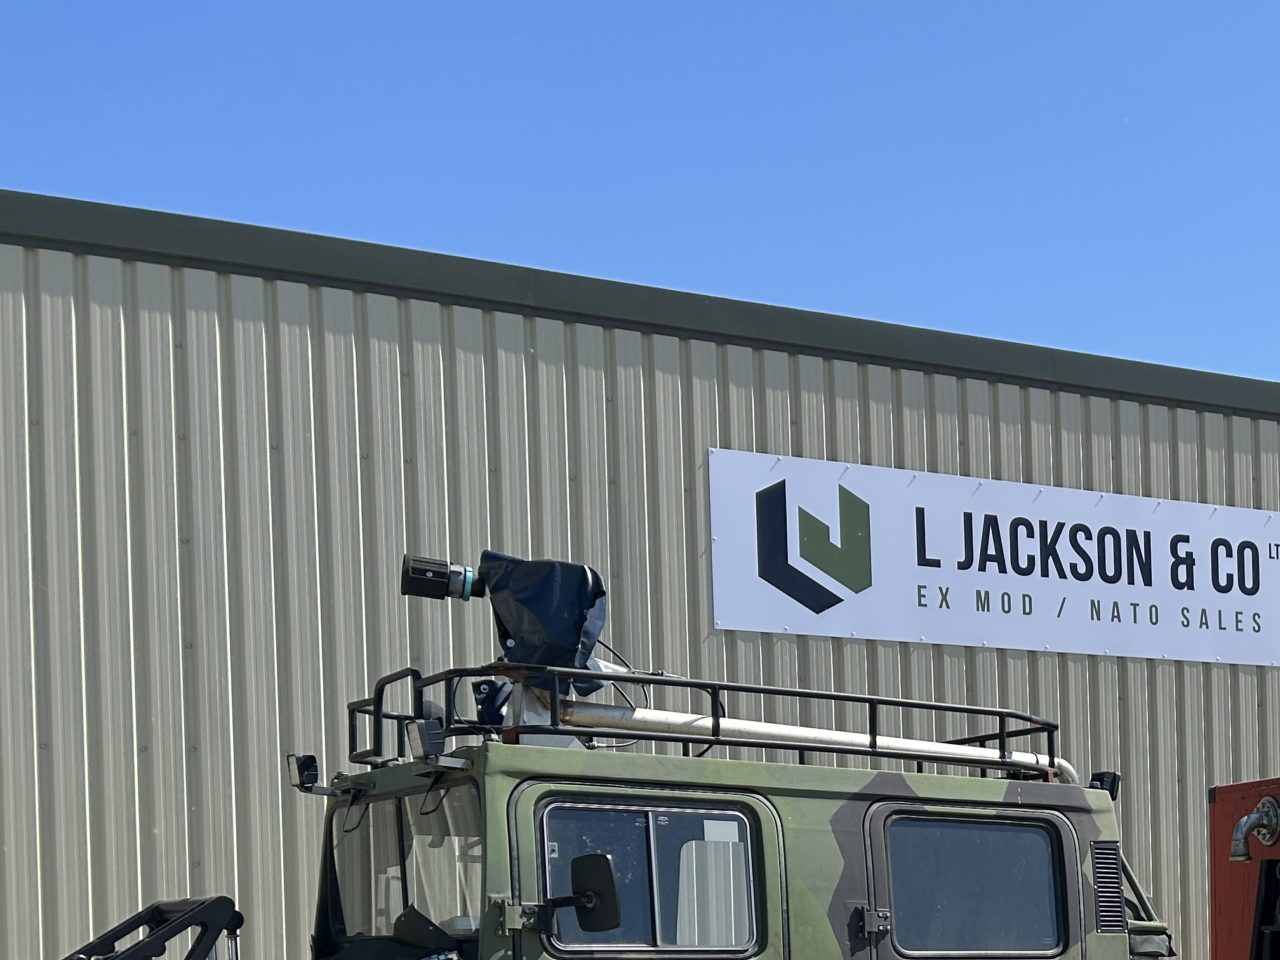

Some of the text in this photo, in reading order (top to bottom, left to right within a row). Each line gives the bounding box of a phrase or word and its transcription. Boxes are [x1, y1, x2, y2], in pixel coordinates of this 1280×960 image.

[914, 506, 942, 569] L
[956, 511, 1153, 588] JACKSON
[1169, 533, 1196, 592] &
[1210, 537, 1261, 597] CO
[916, 584, 1262, 634] EX MOD / NATO SALES
